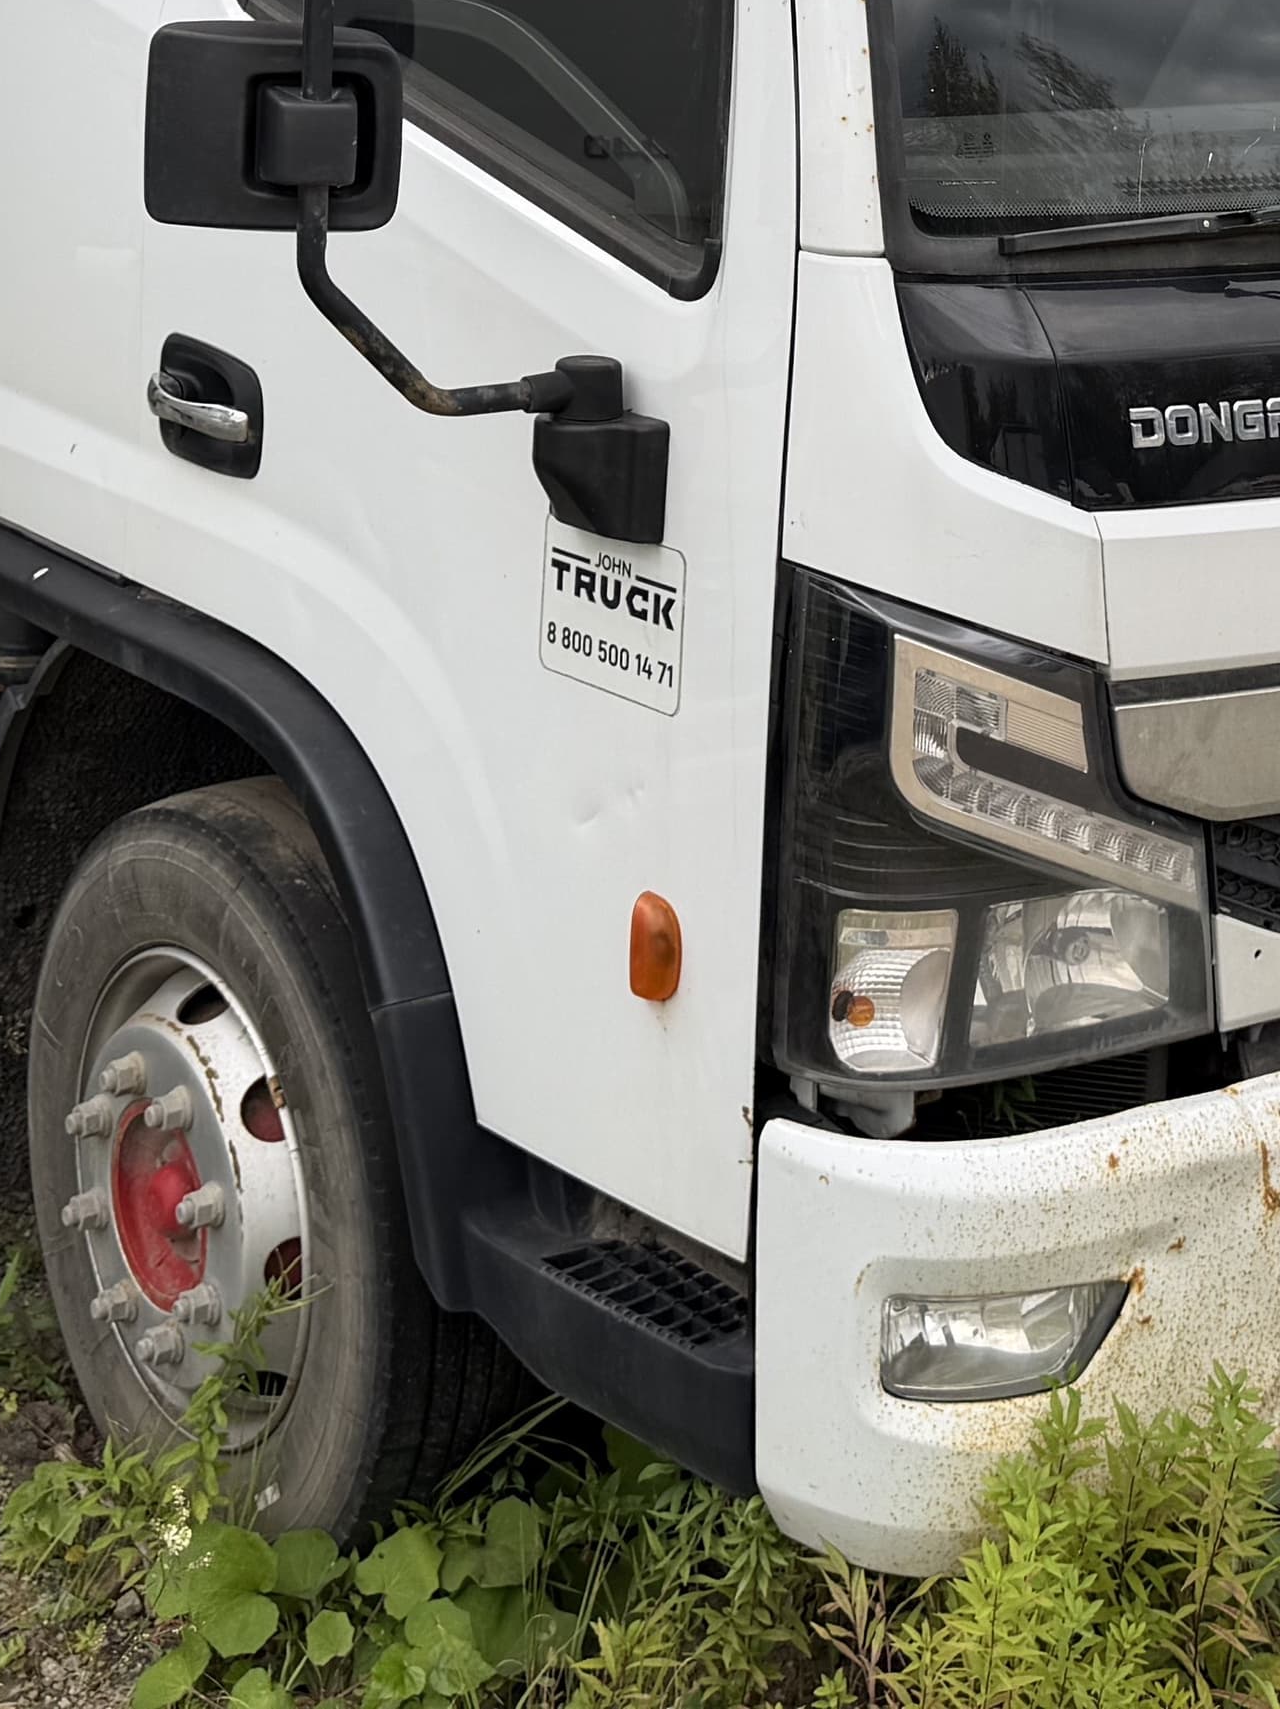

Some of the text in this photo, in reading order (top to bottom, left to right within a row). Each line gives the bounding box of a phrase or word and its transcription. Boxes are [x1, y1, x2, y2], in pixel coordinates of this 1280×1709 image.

[551, 557, 676, 631] TRUCK
[595, 552, 632, 578] JOHN
[547, 621, 674, 688] 8 800 500 14 71
